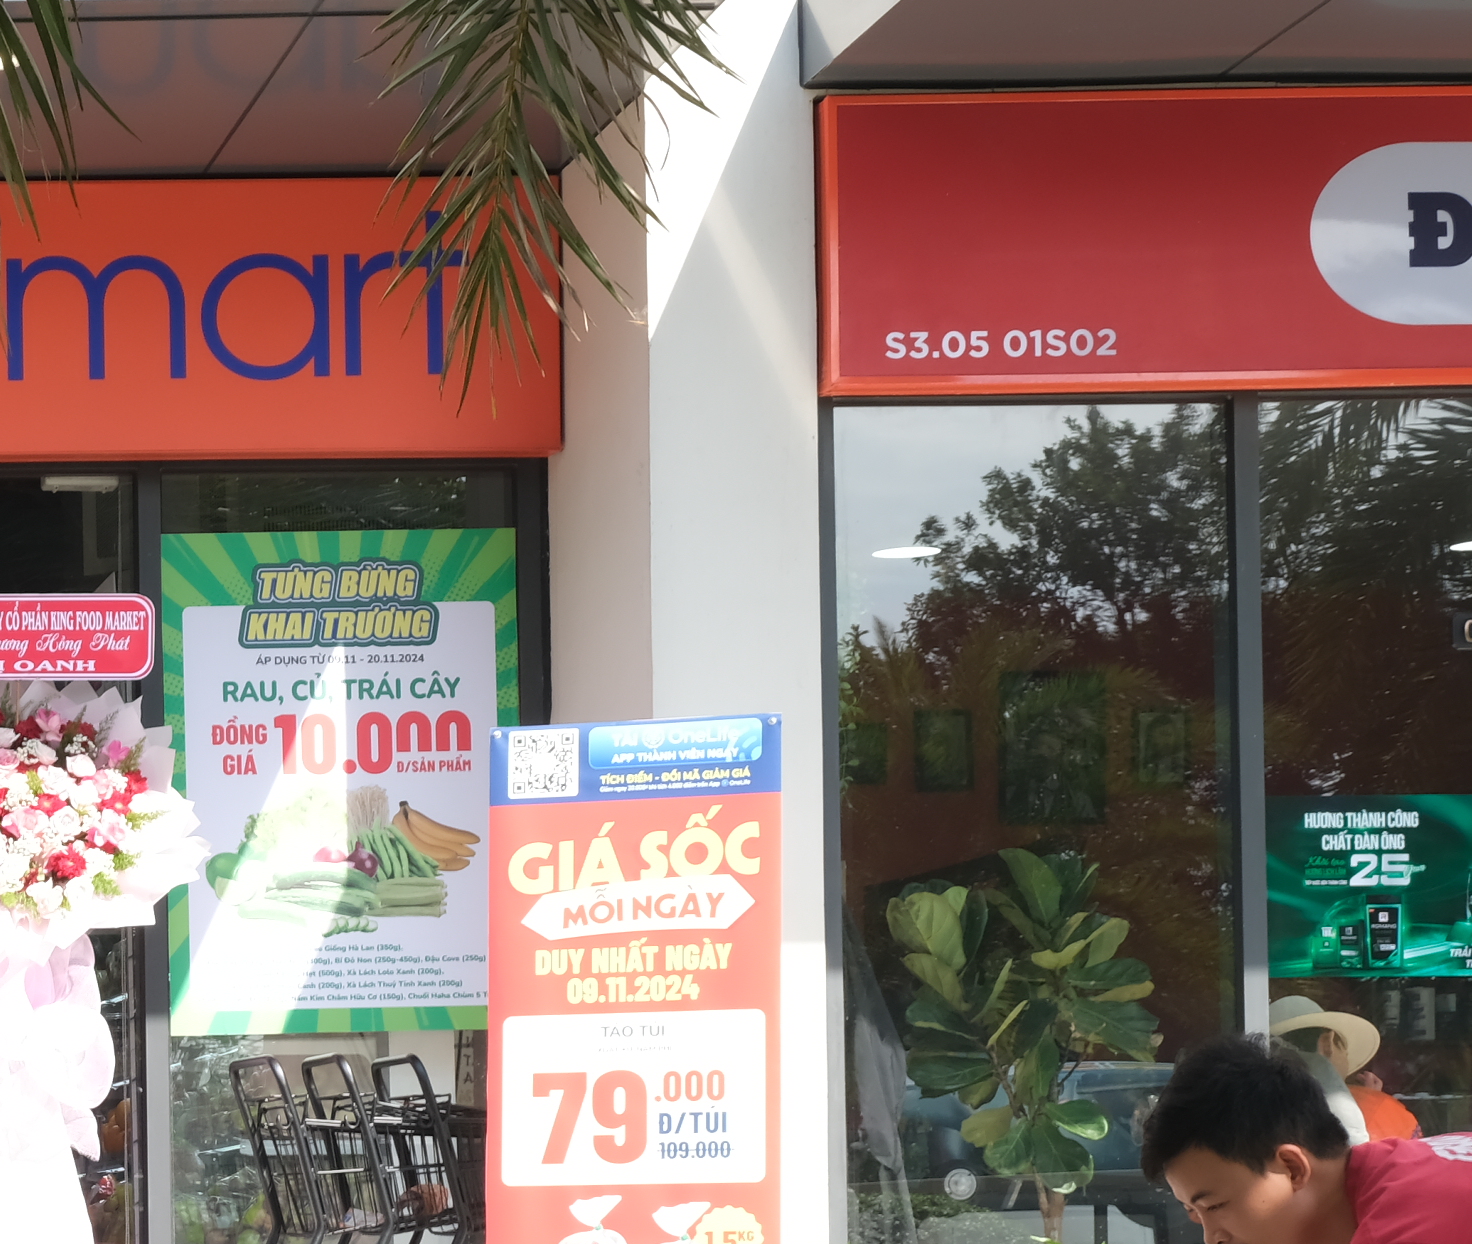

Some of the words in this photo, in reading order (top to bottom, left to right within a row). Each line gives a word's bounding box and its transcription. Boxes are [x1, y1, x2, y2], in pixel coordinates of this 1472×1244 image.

[885, 330, 989, 360] S3.05
[1004, 328, 1117, 357] 01S02
[338, 560, 417, 599] BỪNG
[22, 603, 49, 631] PHẦN
[51, 610, 74, 631] KING
[76, 610, 103, 631] FOOD
[104, 610, 146, 631] MARKET
[247, 611, 314, 641] KHAI
[319, 604, 432, 640] TRƯƠNG
[89, 633, 130, 652] Phát
[13, 659, 97, 672] OANH
[256, 654, 272, 665] ÁP
[274, 655, 307, 667] DỤNG
[310, 652, 325, 664] TỪ
[367, 653, 424, 663] 20.11.2024
[222, 679, 284, 705] RAU,
[292, 672, 333, 703] CỦ,
[346, 675, 402, 699] TRÁI
[410, 671, 460, 698] CÂY
[211, 716, 268, 745] ĐỒNG
[667, 726, 740, 744] OneLife
[222, 749, 257, 775] GIÁ
[397, 758, 436, 772] Đ/SẢN
[438, 755, 472, 772] PHẨM
[611, 753, 635, 764] APP
[637, 749, 676, 762] THÀNH
[678, 747, 704, 760] VIÊN
[600, 772, 624, 784] TÍCH
[626, 770, 652, 783] ĐIỂM
[731, 765, 750, 778] GIÁ
[1304, 812, 1345, 829] HƯƠNG
[1346, 810, 1386, 828] THÀNH
[1388, 809, 1420, 828] CÔNG
[508, 821, 626, 895] GIÁ
[640, 804, 761, 879] SỐC
[1321, 829, 1351, 851] CHẤT
[1354, 831, 1380, 850] ĐÀN
[1381, 831, 1406, 850] ÔNG
[1349, 853, 1411, 887] 25
[562, 887, 624, 929] MỖI
[633, 885, 725, 920] NGÀY
[535, 948, 585, 976] DUY
[591, 937, 659, 974] NHẤT
[665, 938, 732, 970] NGÀY
[567, 974, 700, 1005] 09.11.2024
[659, 1105, 727, 1135] Đ/TÚI
[658, 1141, 734, 1160] 109.000
